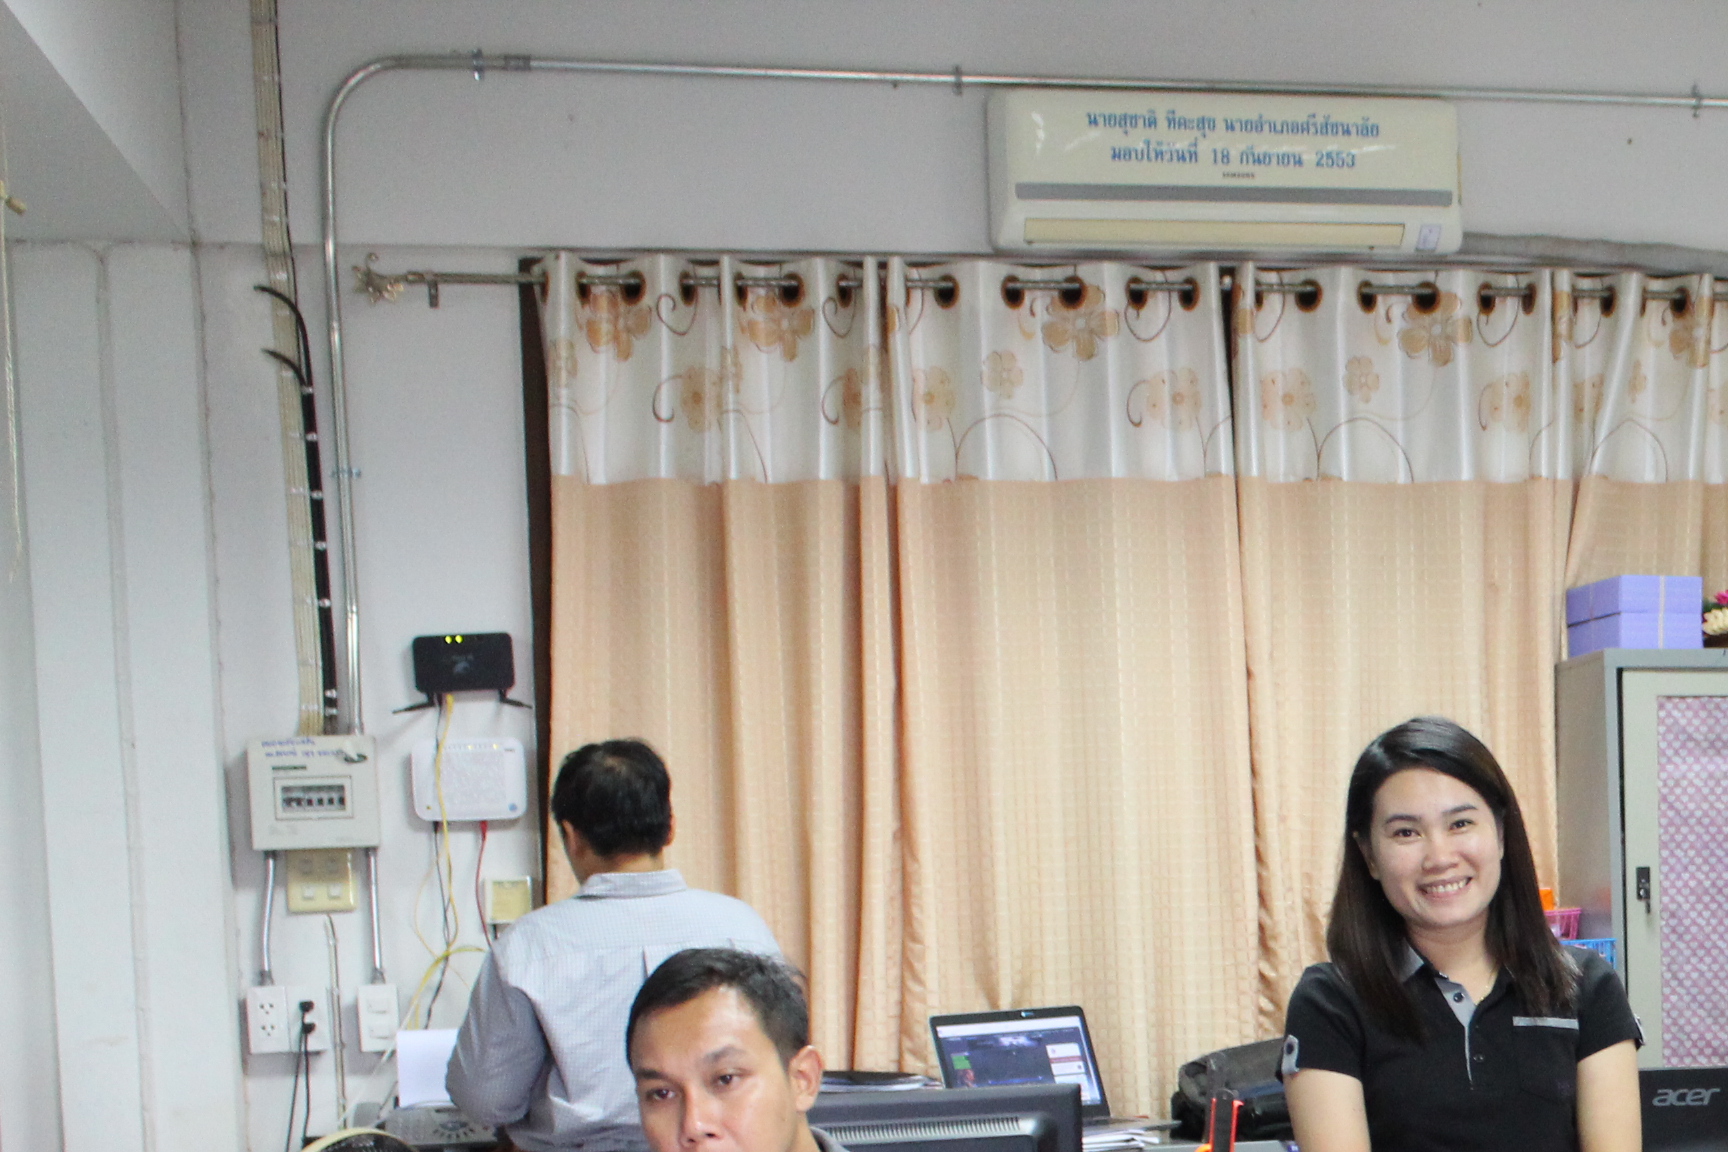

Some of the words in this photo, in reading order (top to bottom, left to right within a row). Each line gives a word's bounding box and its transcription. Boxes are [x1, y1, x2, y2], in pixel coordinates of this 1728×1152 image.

[1111, 137, 1198, 163] มอบให้วันที่
[1212, 147, 1230, 165] 18
[1239, 145, 1304, 168] กันยายน
[1315, 151, 1356, 168] 2553
[1652, 1087, 1721, 1107] acer
